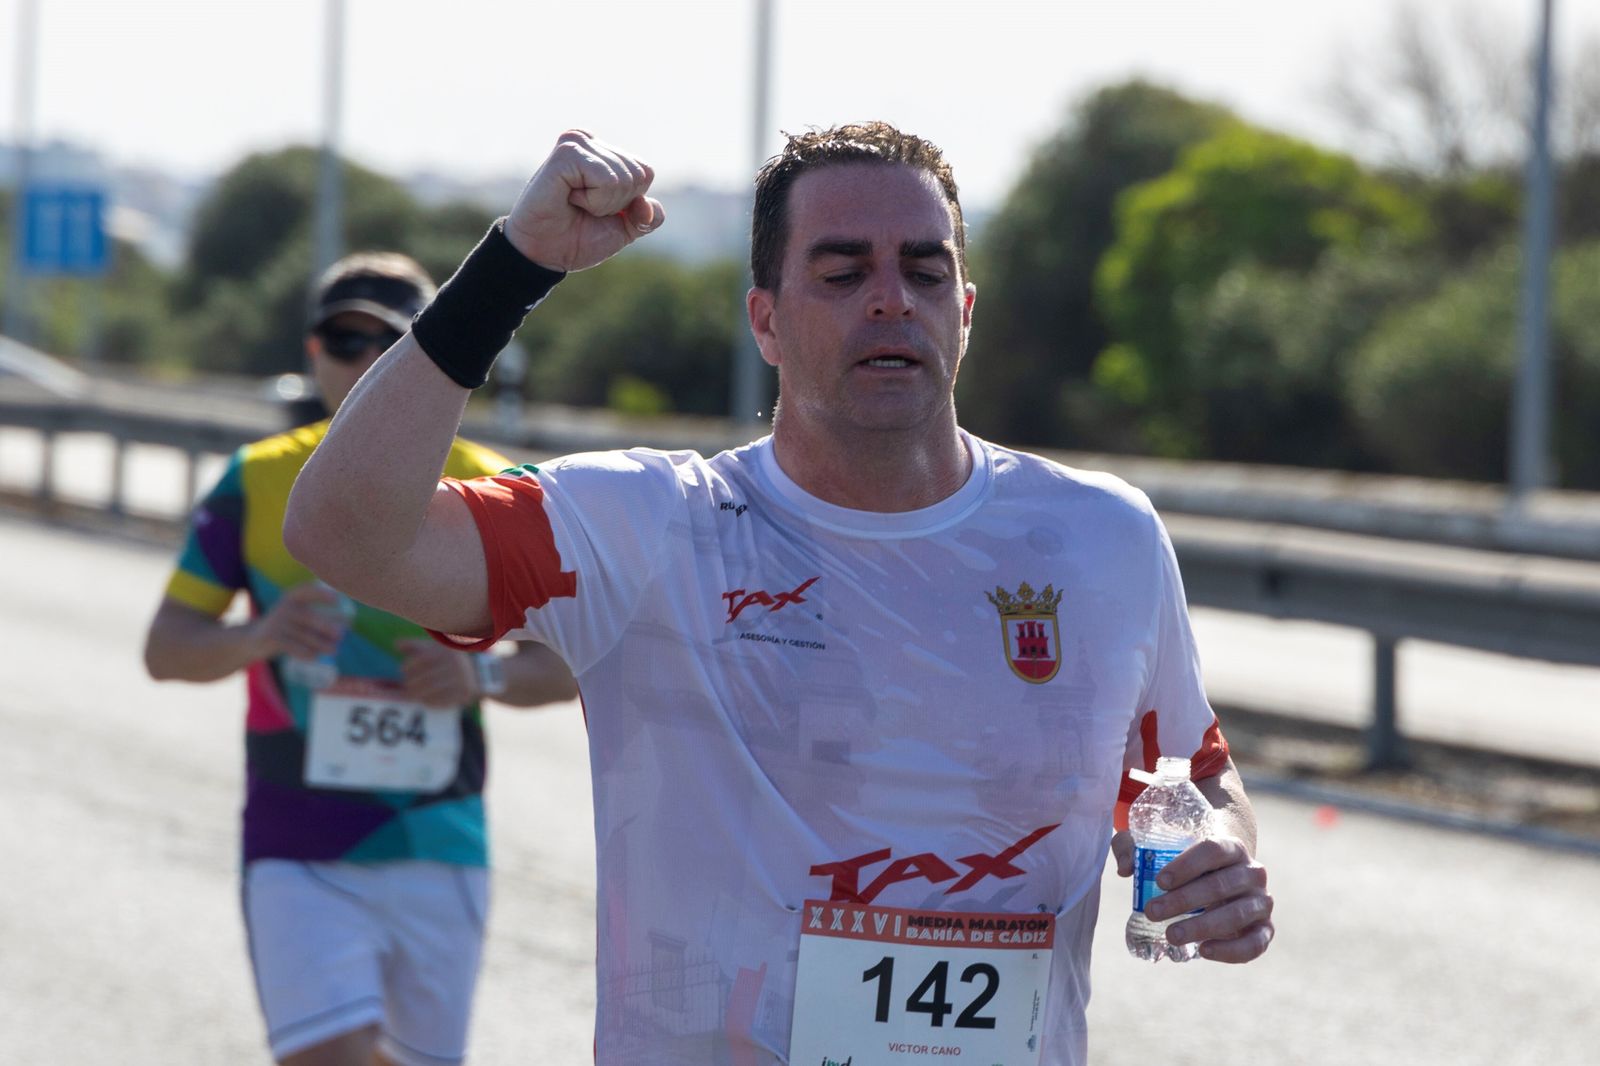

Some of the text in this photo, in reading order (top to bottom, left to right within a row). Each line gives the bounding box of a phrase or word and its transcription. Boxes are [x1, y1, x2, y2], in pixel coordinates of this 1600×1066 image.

[739, 632, 780, 645] ASESORÍA
[789, 639, 826, 650] GESTIÓN
[348, 705, 428, 747] 564
[809, 823, 1062, 905] TAX
[809, 906, 902, 937] XXXVI
[907, 915, 964, 929] MEDIA
[906, 926, 1047, 944] BAHÍA DE CÁDIZ
[862, 956, 1000, 1030] 142
[888, 1042, 962, 1057] VICTOR CANO
